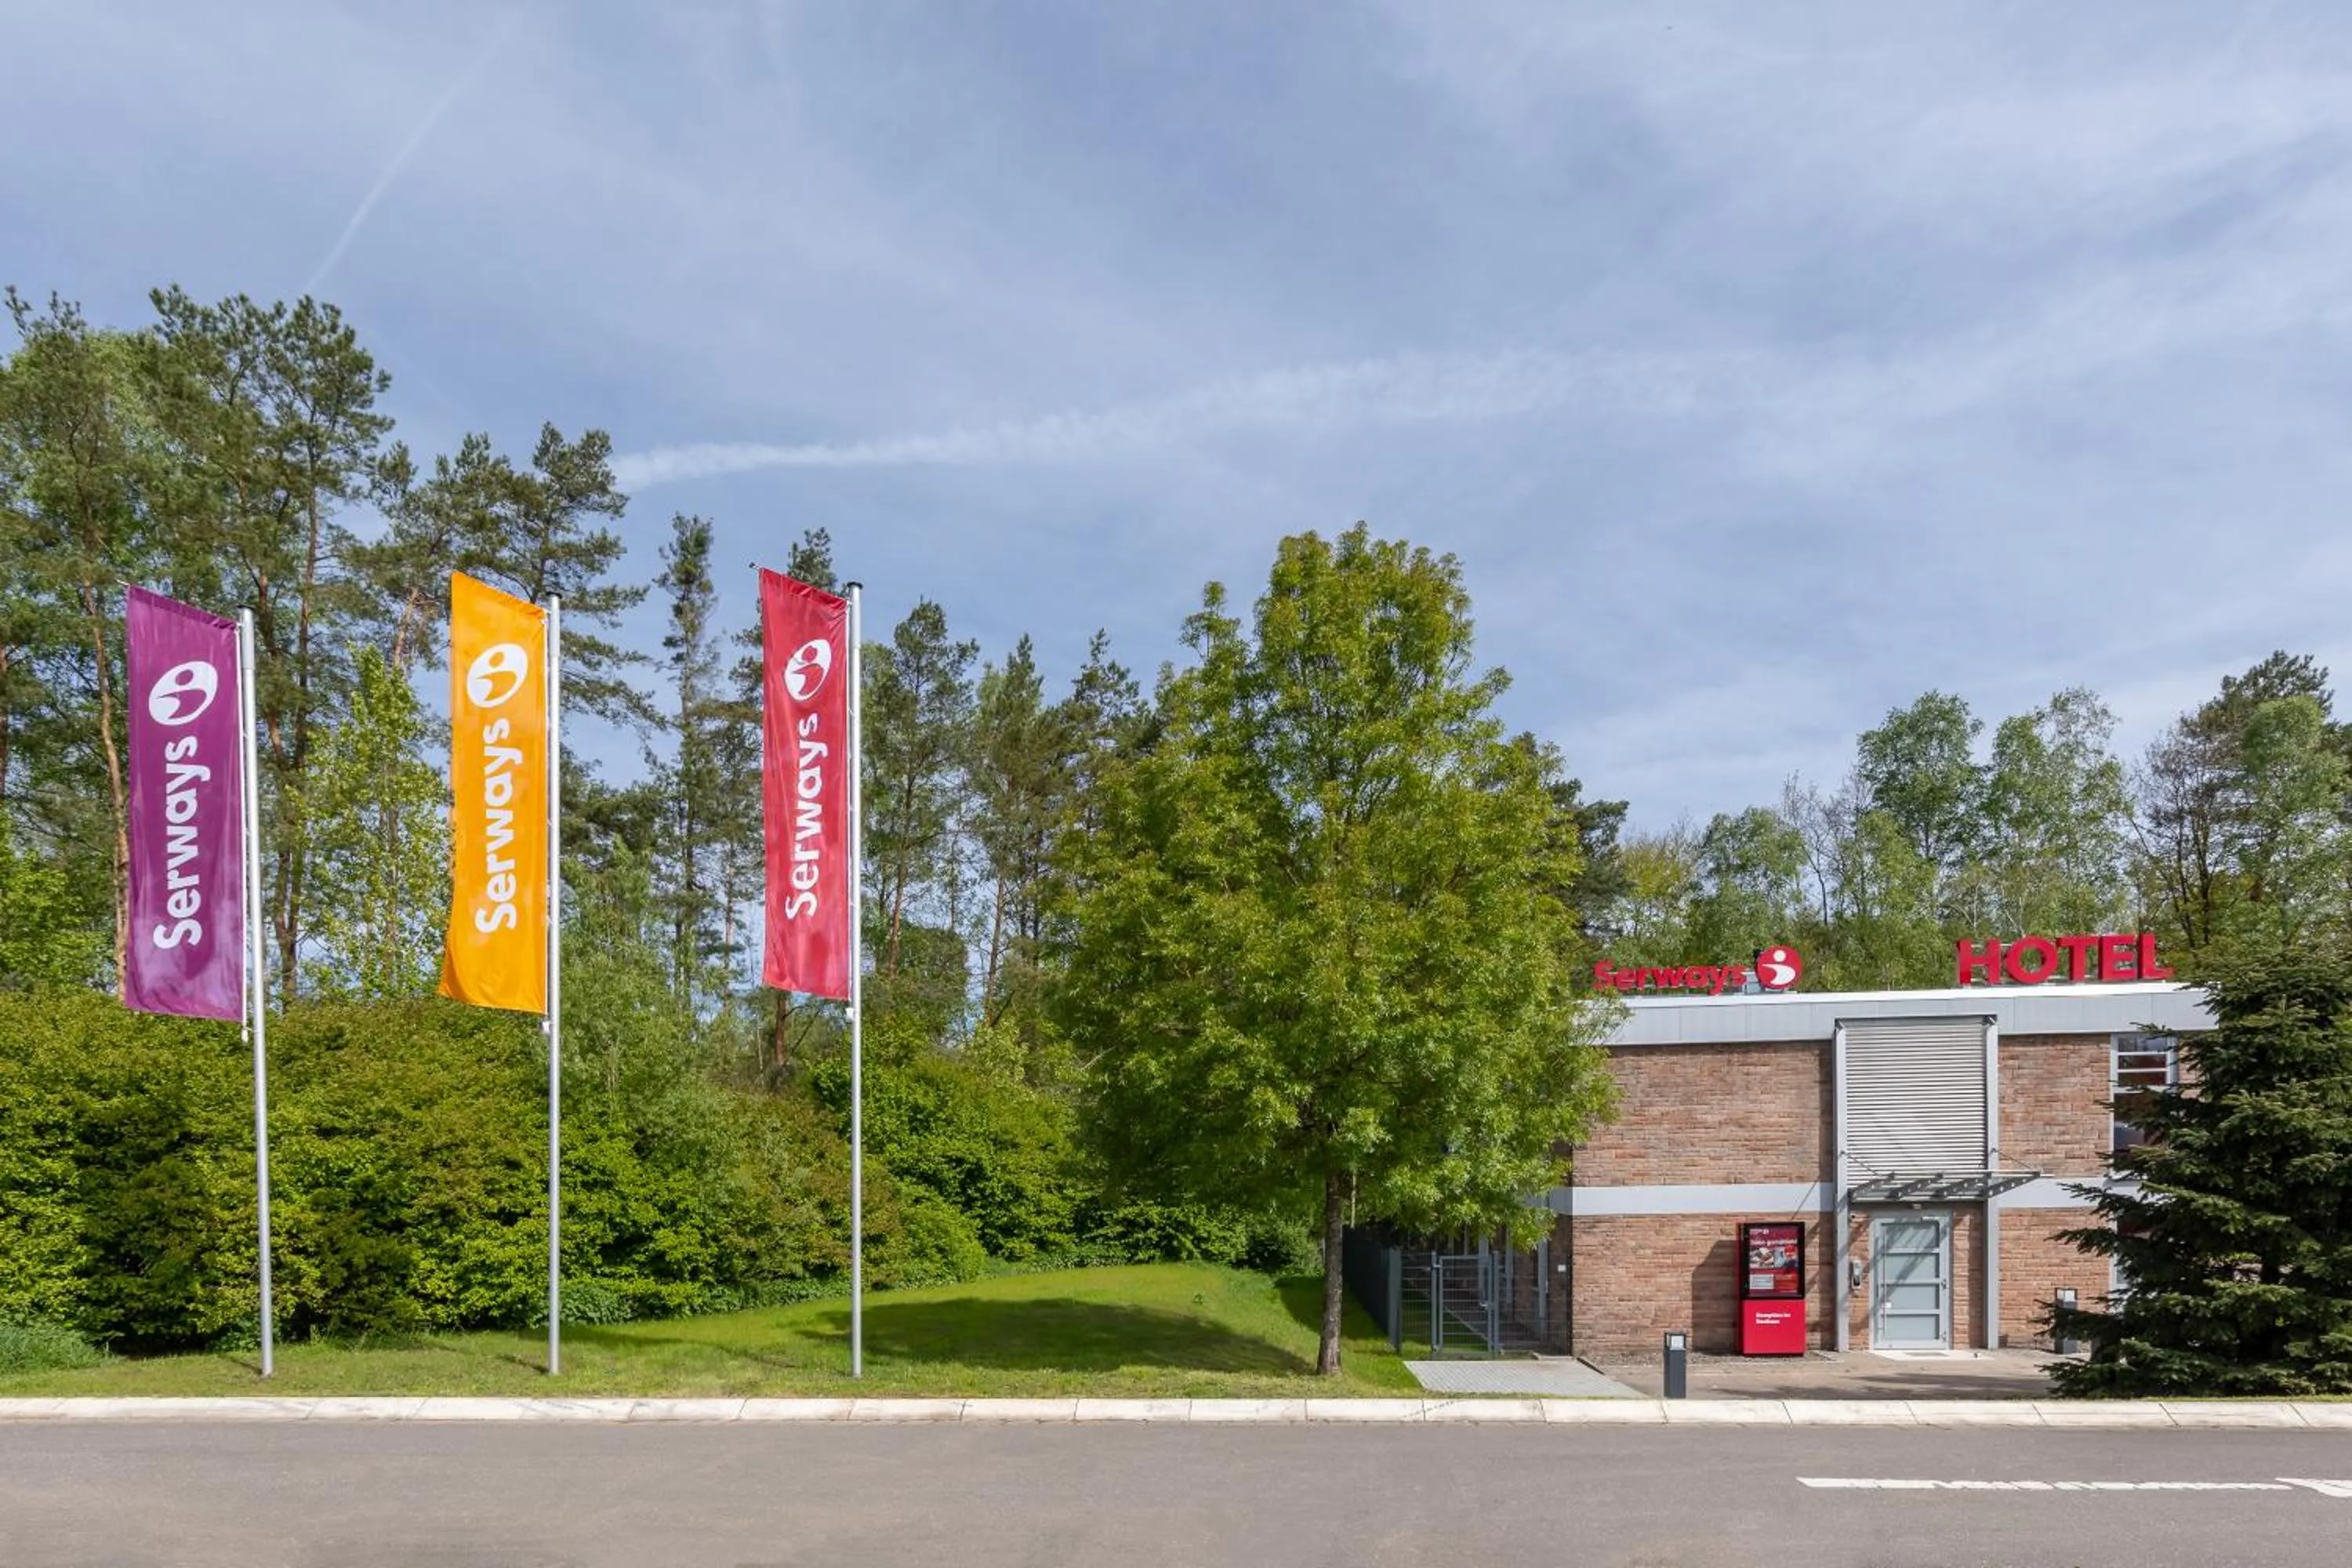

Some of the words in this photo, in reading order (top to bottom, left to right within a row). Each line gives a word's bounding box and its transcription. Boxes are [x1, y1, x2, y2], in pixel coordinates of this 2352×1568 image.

[153, 735, 211, 949] Serways
[475, 717, 522, 933] Serways
[785, 713, 828, 920] Serways
[1593, 960, 1748, 996] Serways
[1956, 933, 2173, 985] HOTEL
